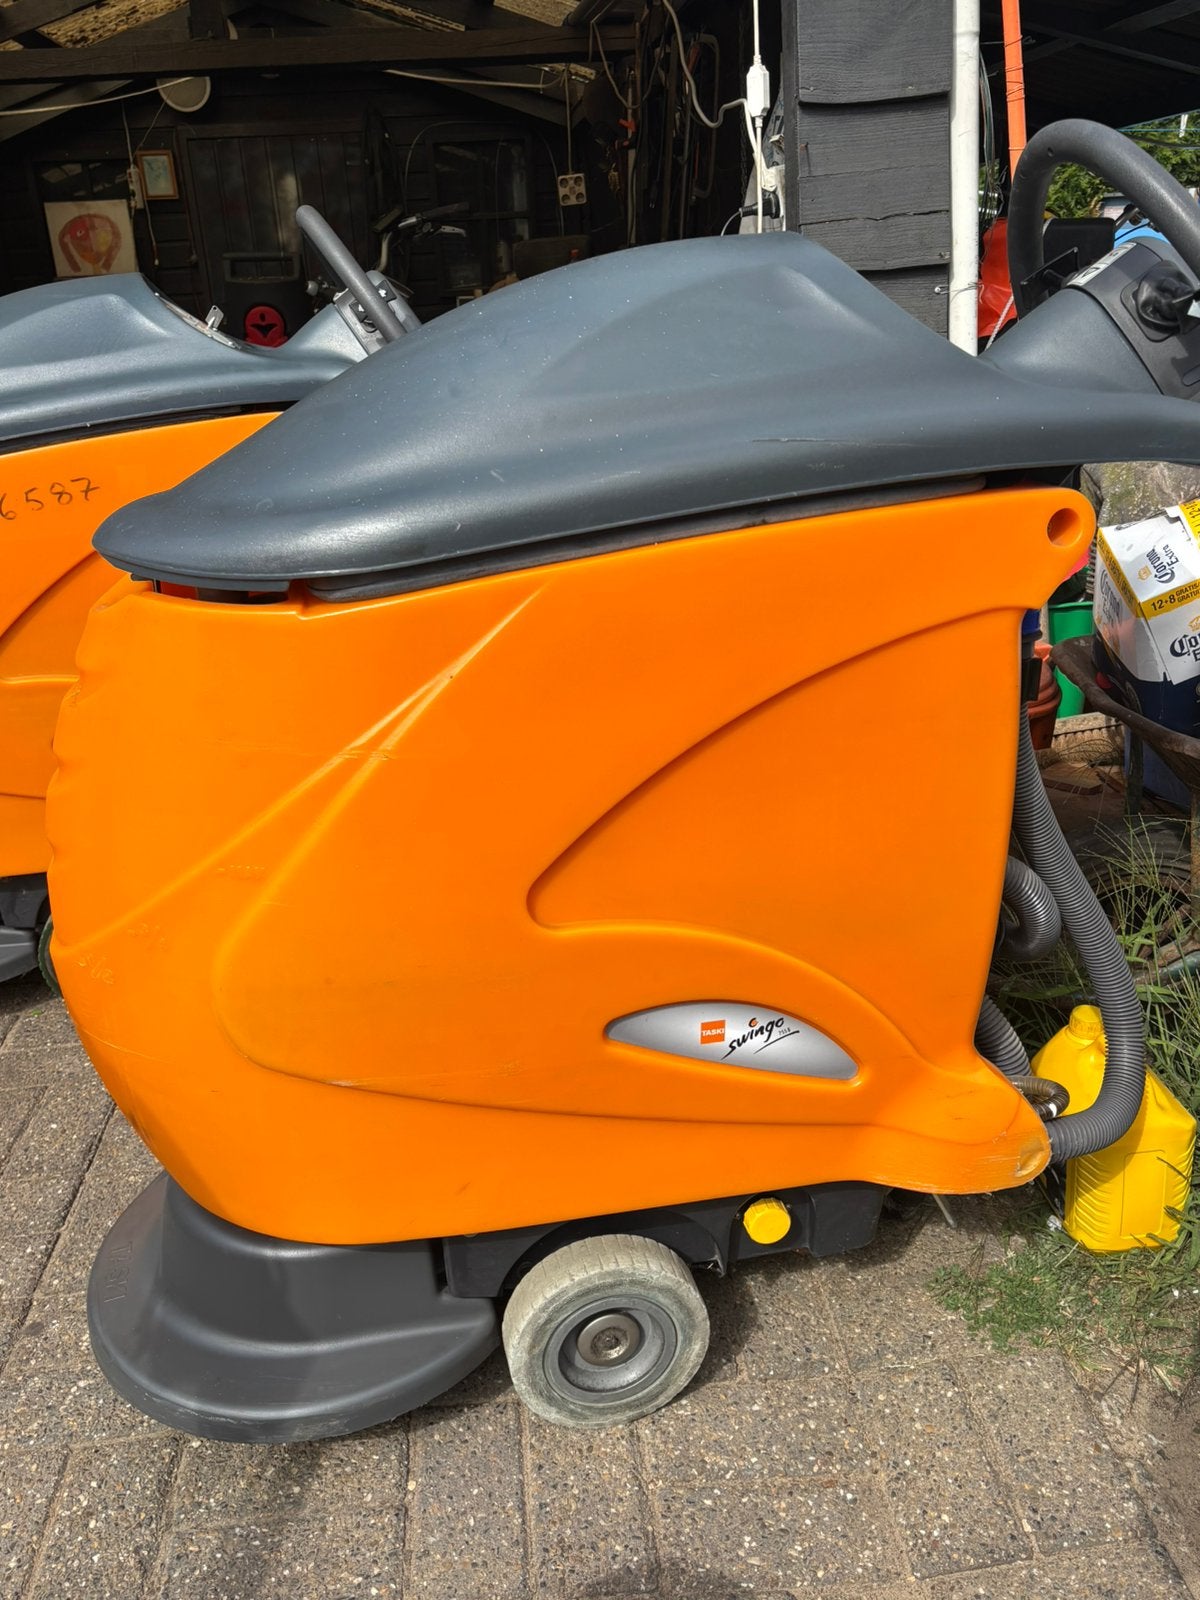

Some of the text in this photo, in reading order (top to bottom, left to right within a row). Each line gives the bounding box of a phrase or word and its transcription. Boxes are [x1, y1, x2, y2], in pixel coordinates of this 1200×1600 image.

[1146, 548, 1176, 584] Corona
[702, 1028, 725, 1037] TASKI
[720, 1017, 784, 1060] swingo
